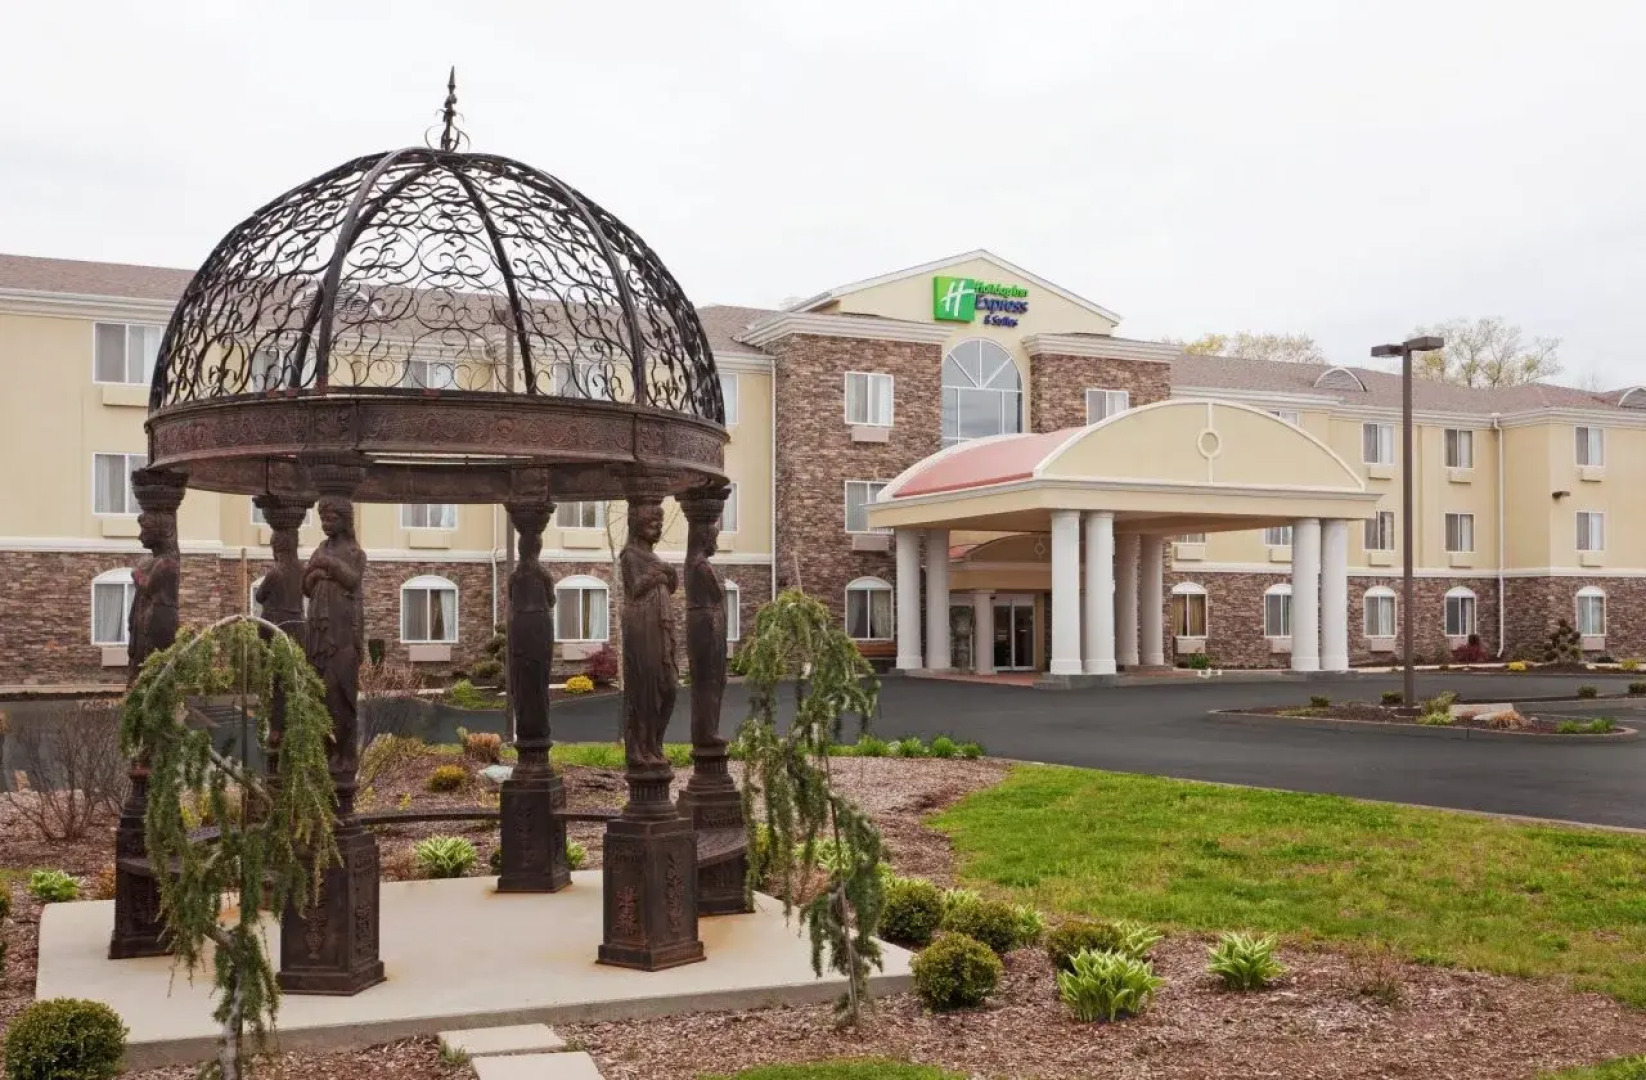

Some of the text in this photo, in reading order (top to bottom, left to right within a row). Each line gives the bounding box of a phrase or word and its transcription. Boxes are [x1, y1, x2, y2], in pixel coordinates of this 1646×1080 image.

[975, 282, 1028, 298] Holiday Inn
[975, 294, 1028, 314] Express
[983, 315, 1018, 328] & Suites
